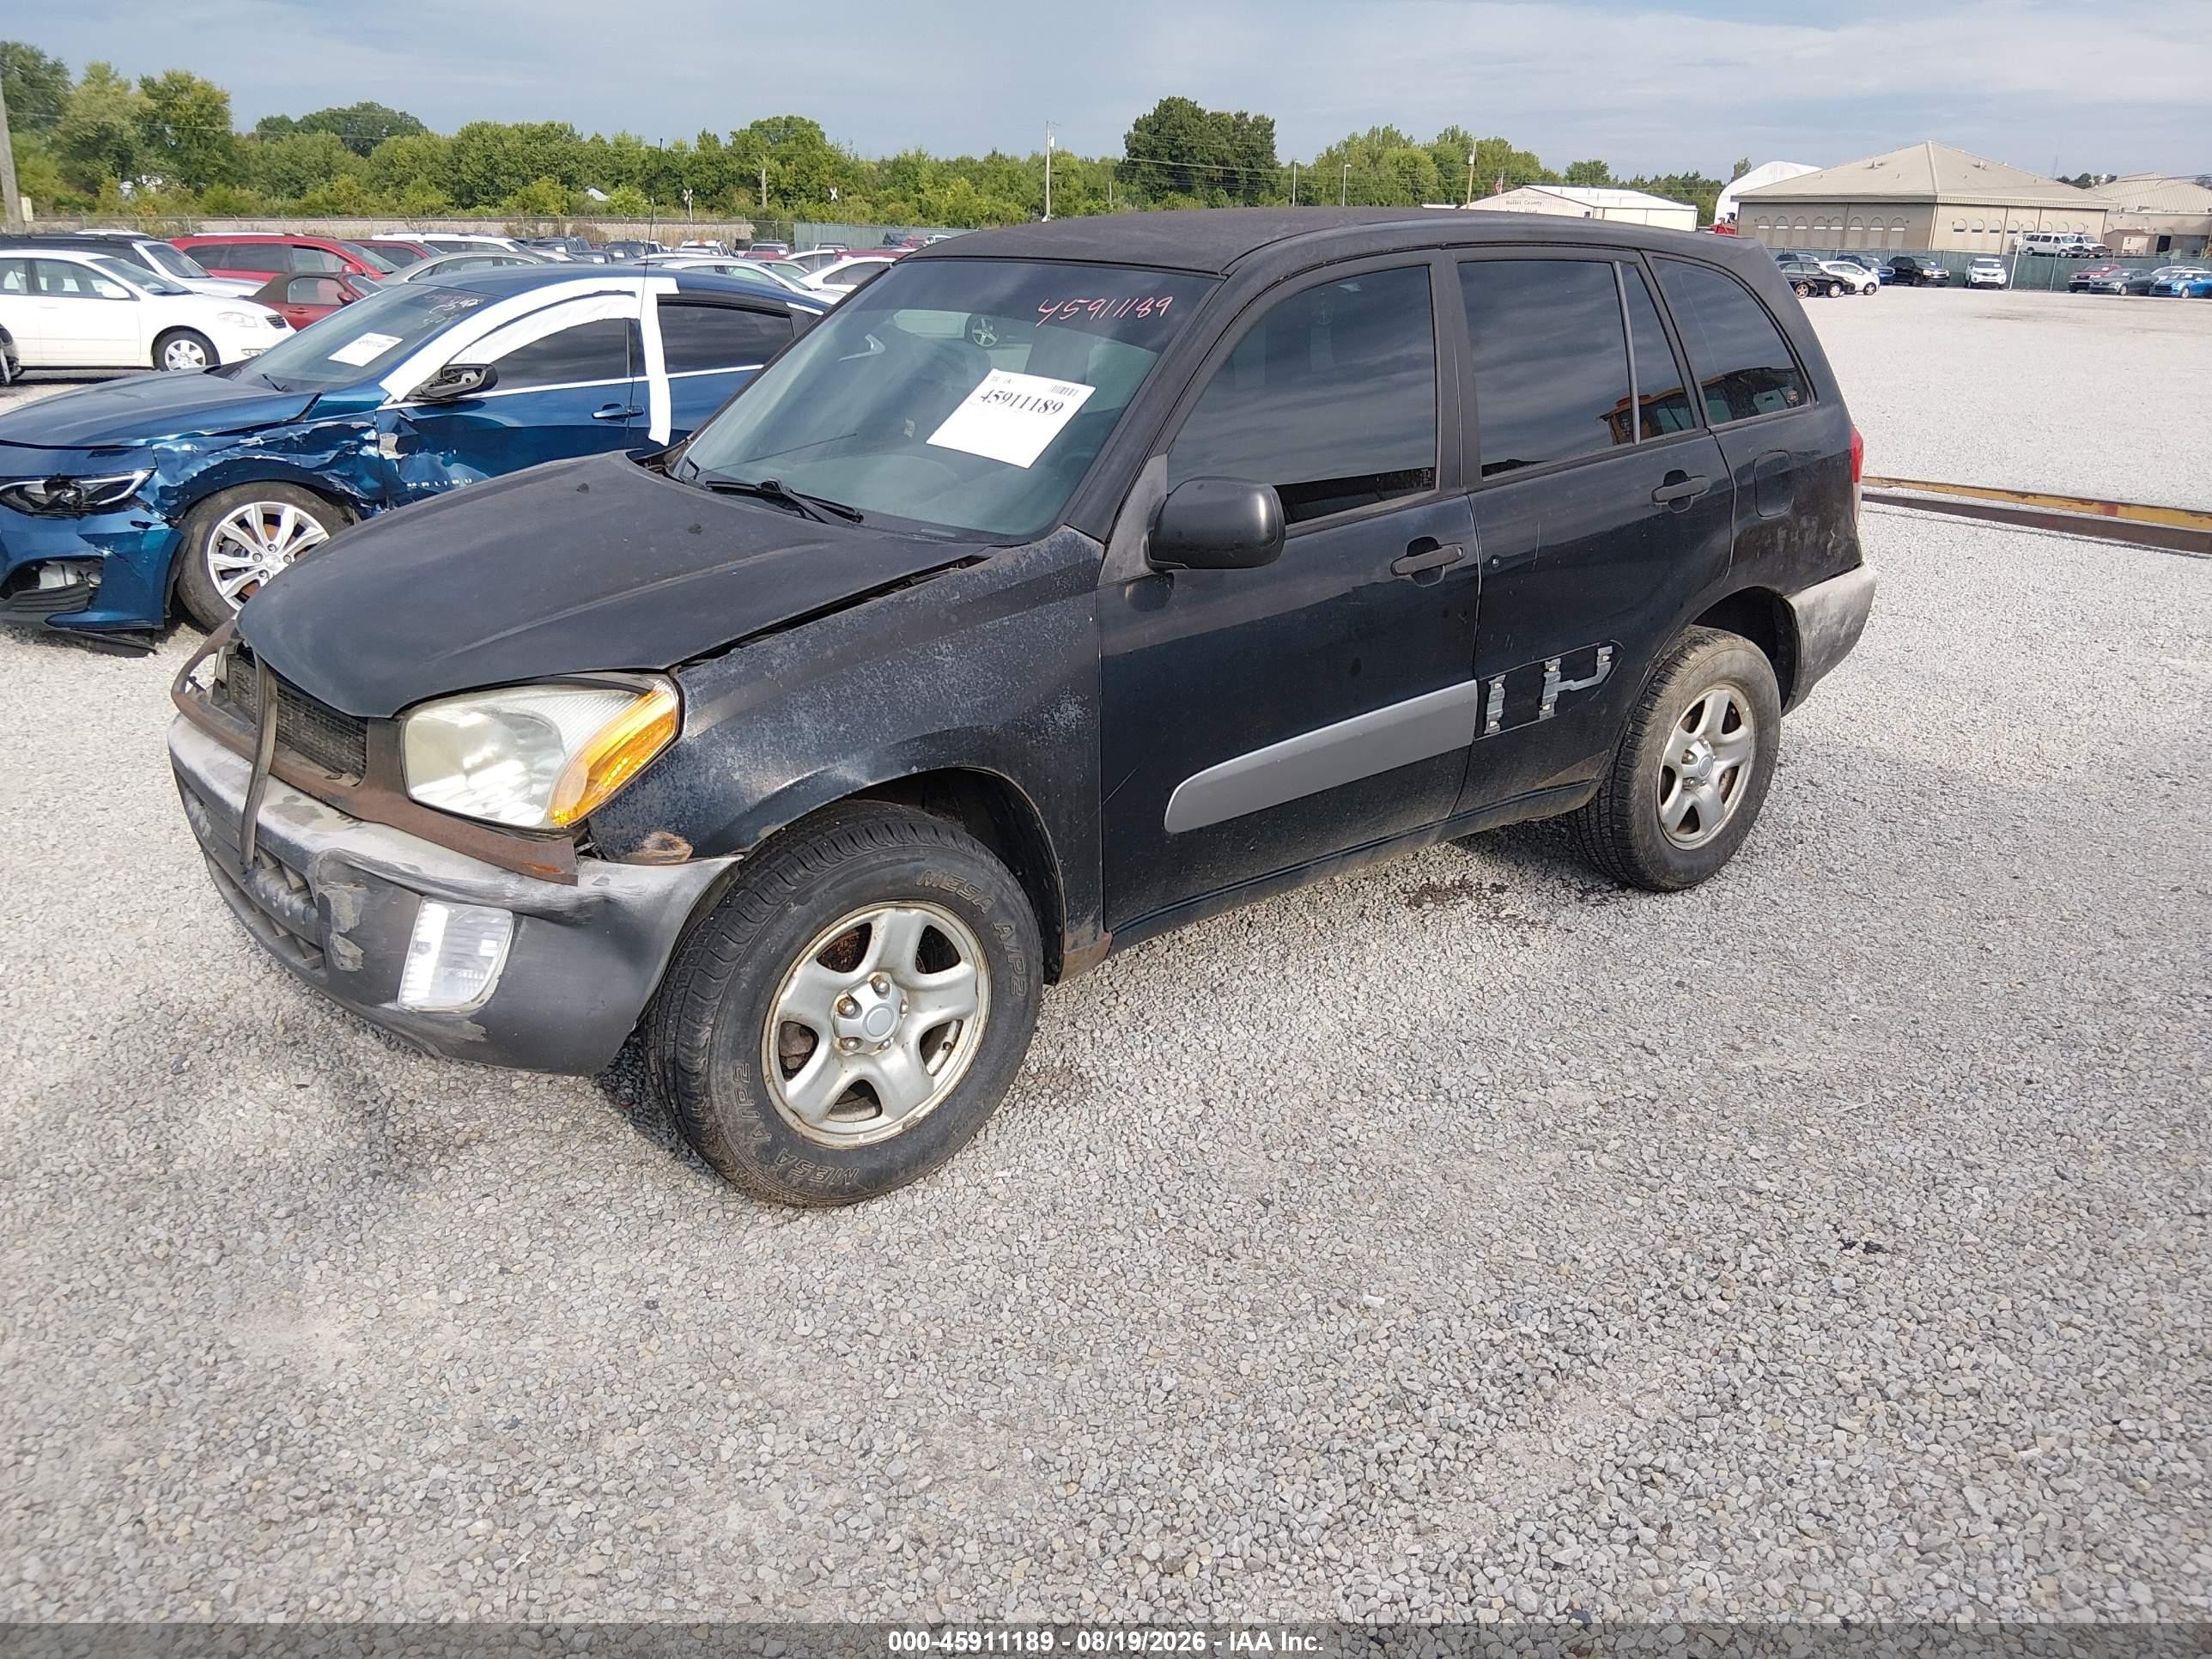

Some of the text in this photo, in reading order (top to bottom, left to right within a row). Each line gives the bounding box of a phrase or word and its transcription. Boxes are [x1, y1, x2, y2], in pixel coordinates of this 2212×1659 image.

[1036, 295, 1174, 327] 45911189
[981, 389, 1064, 415] 45911189
[915, 870, 995, 914] MESA
[775, 1148, 859, 1185] MESA
